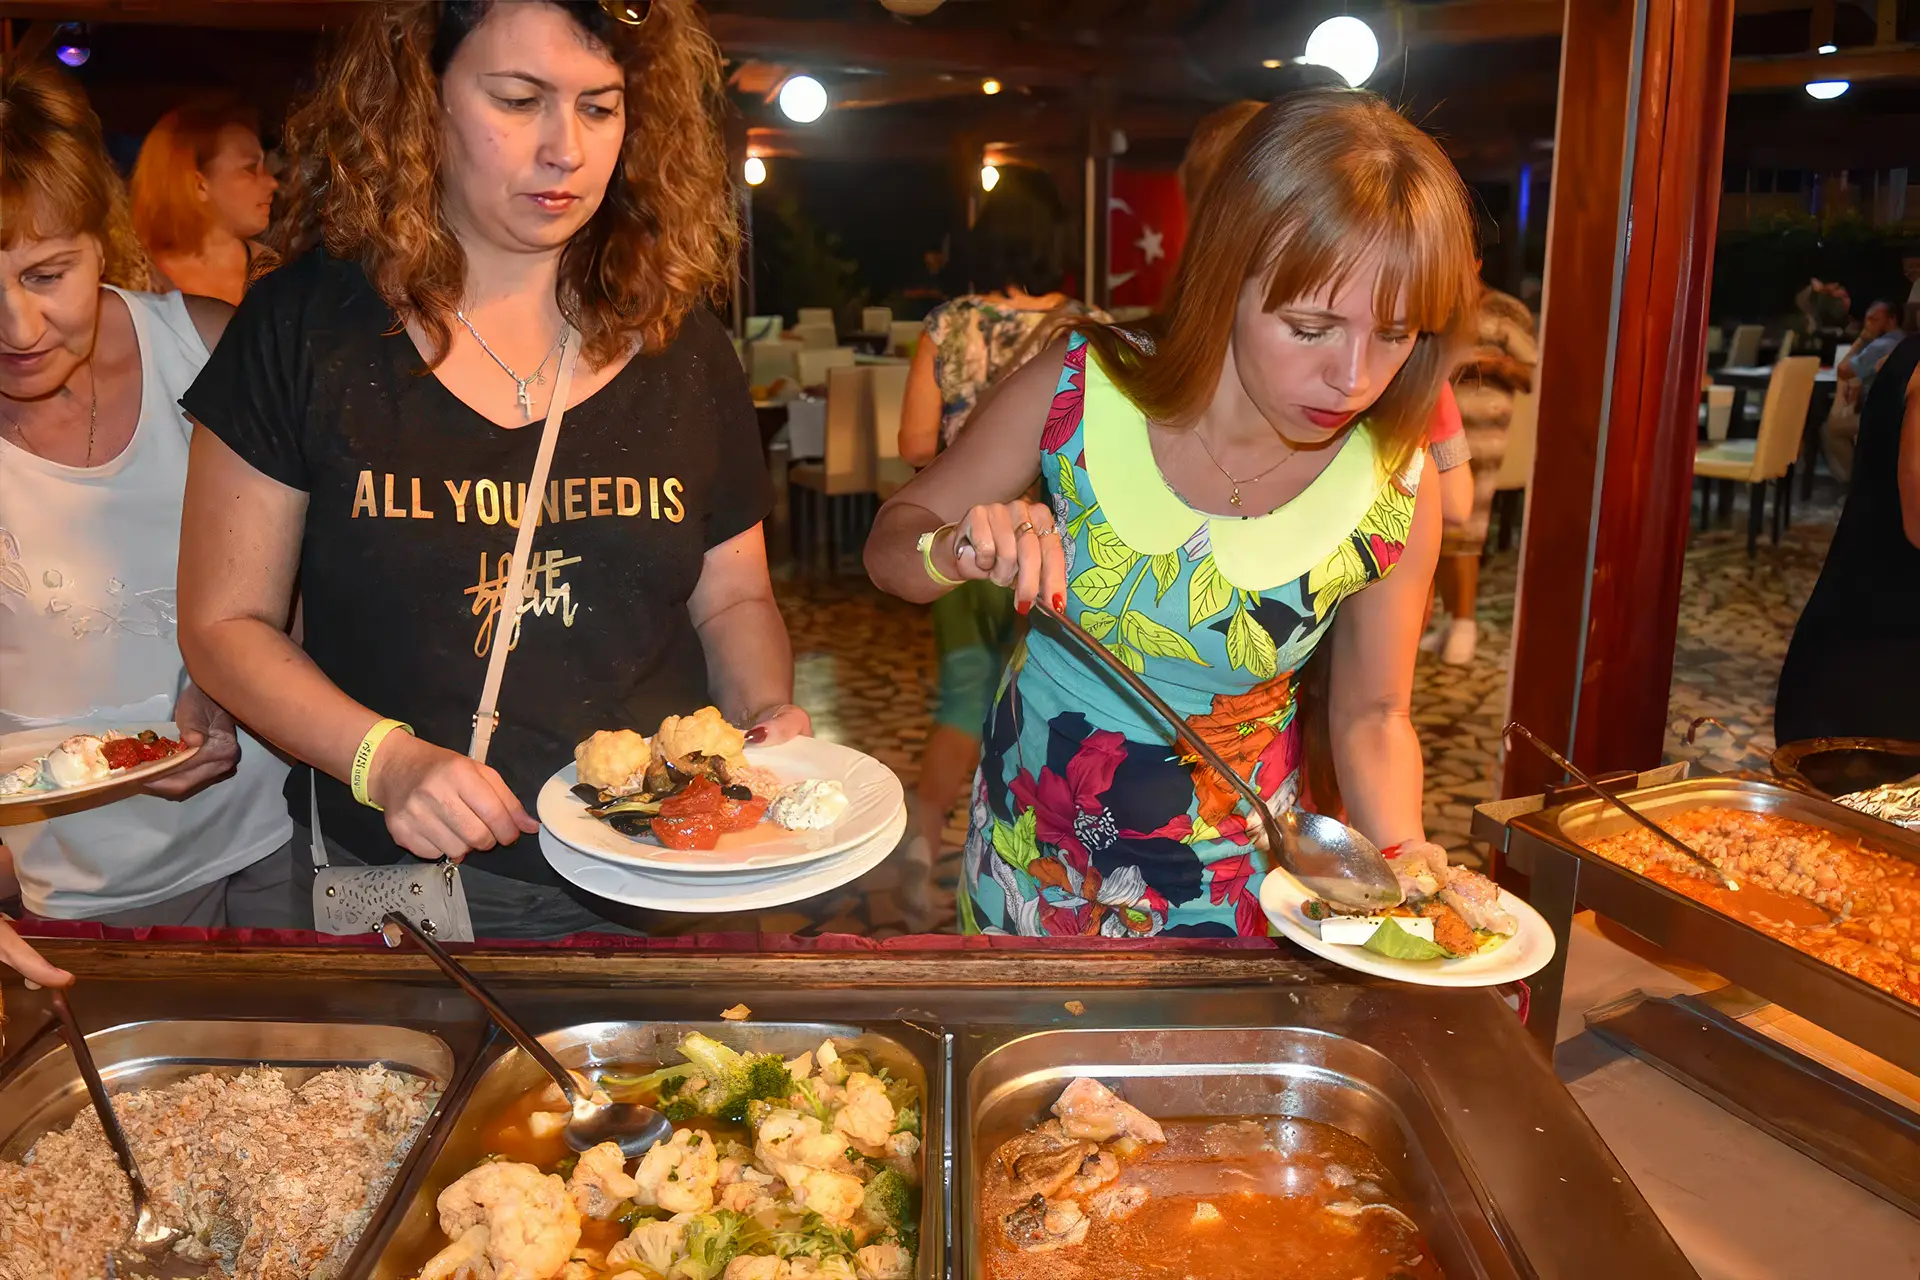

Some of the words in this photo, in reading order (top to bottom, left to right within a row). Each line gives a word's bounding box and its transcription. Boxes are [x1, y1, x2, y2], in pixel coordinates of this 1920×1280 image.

[351, 470, 434, 518] ALL
[444, 478, 527, 529] YOU
[536, 476, 642, 527] NEED
[649, 477, 685, 523] IS
